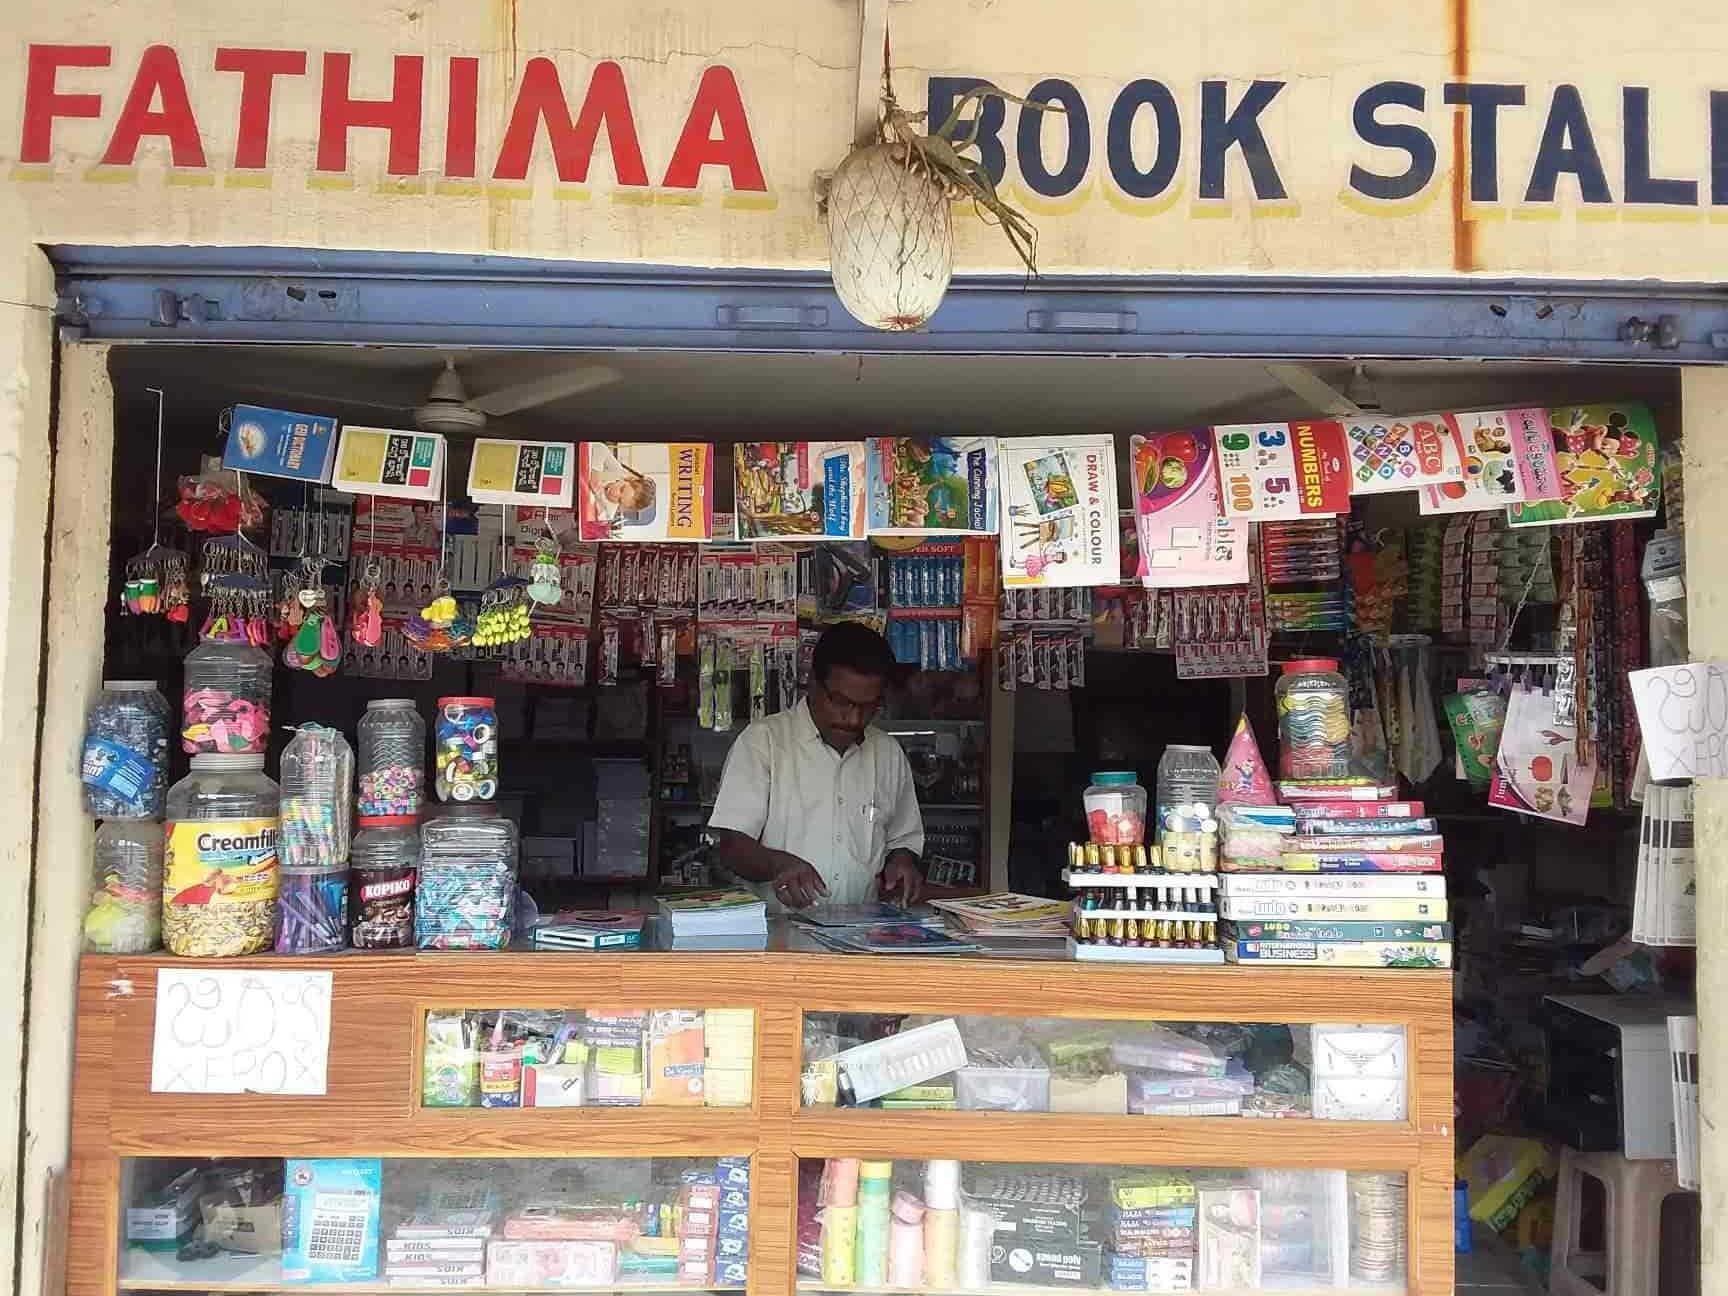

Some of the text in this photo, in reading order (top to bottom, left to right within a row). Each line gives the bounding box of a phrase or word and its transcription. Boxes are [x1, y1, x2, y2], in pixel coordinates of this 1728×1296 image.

[20, 44, 768, 191] FATHIMA
[928, 77, 1728, 205] BOOK STAL
[1222, 432, 1249, 451] 9
[1258, 430, 1285, 447] 3
[1421, 430, 1440, 468] ABC
[1265, 477, 1290, 494] 5
[1297, 425, 1322, 508] NUMBERS
[677, 448, 693, 528] WRITING
[972, 452, 984, 530] The Cunning Jackal
[1230, 475, 1253, 511] 100
[1086, 454, 1102, 565] DRAW & COLOUR
[364, 878, 411, 899] KOPIKO
[1260, 949, 1316, 960] BUSINESS
